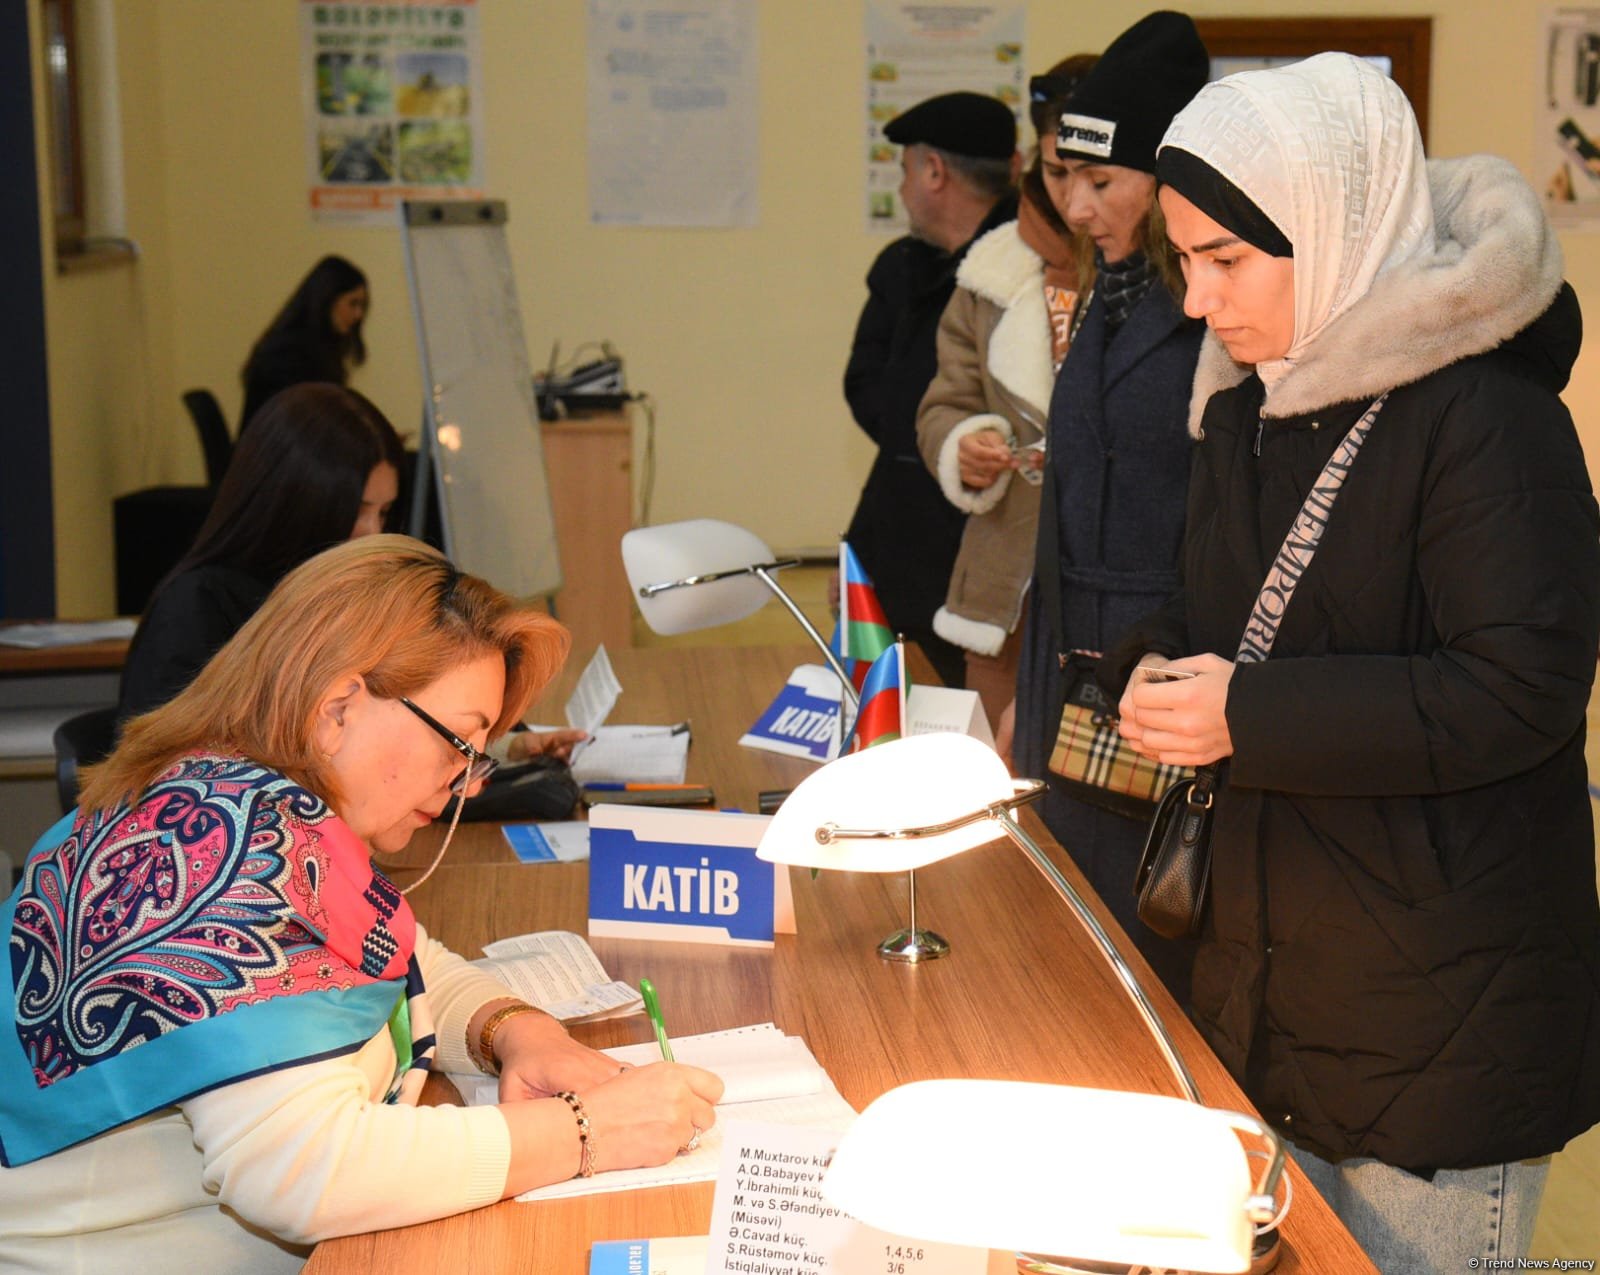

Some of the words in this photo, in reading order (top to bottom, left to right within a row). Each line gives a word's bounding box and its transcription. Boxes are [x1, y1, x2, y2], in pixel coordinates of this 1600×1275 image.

[1058, 122, 1109, 144] upreme
[768, 706, 837, 743] KATİB
[623, 857, 739, 915] KATİB
[740, 1148, 809, 1165] M.Muxtarov
[738, 1164, 815, 1183] A.Q.Babayev
[736, 1179, 799, 1197] Y.İbrahimli
[733, 1195, 746, 1207] M.
[751, 1200, 764, 1209] və
[768, 1199, 840, 1218] S.Əfəndiyev
[731, 1211, 782, 1229] (Müsəvi)
[729, 1226, 780, 1243] Ə.Cavad
[783, 1233, 808, 1248] küç.
[727, 1242, 800, 1261] S.Rüstəmov
[803, 1251, 828, 1267] küç.
[885, 1245, 924, 1261] 1,4,5,6
[887, 1262, 905, 1275] 3/6
